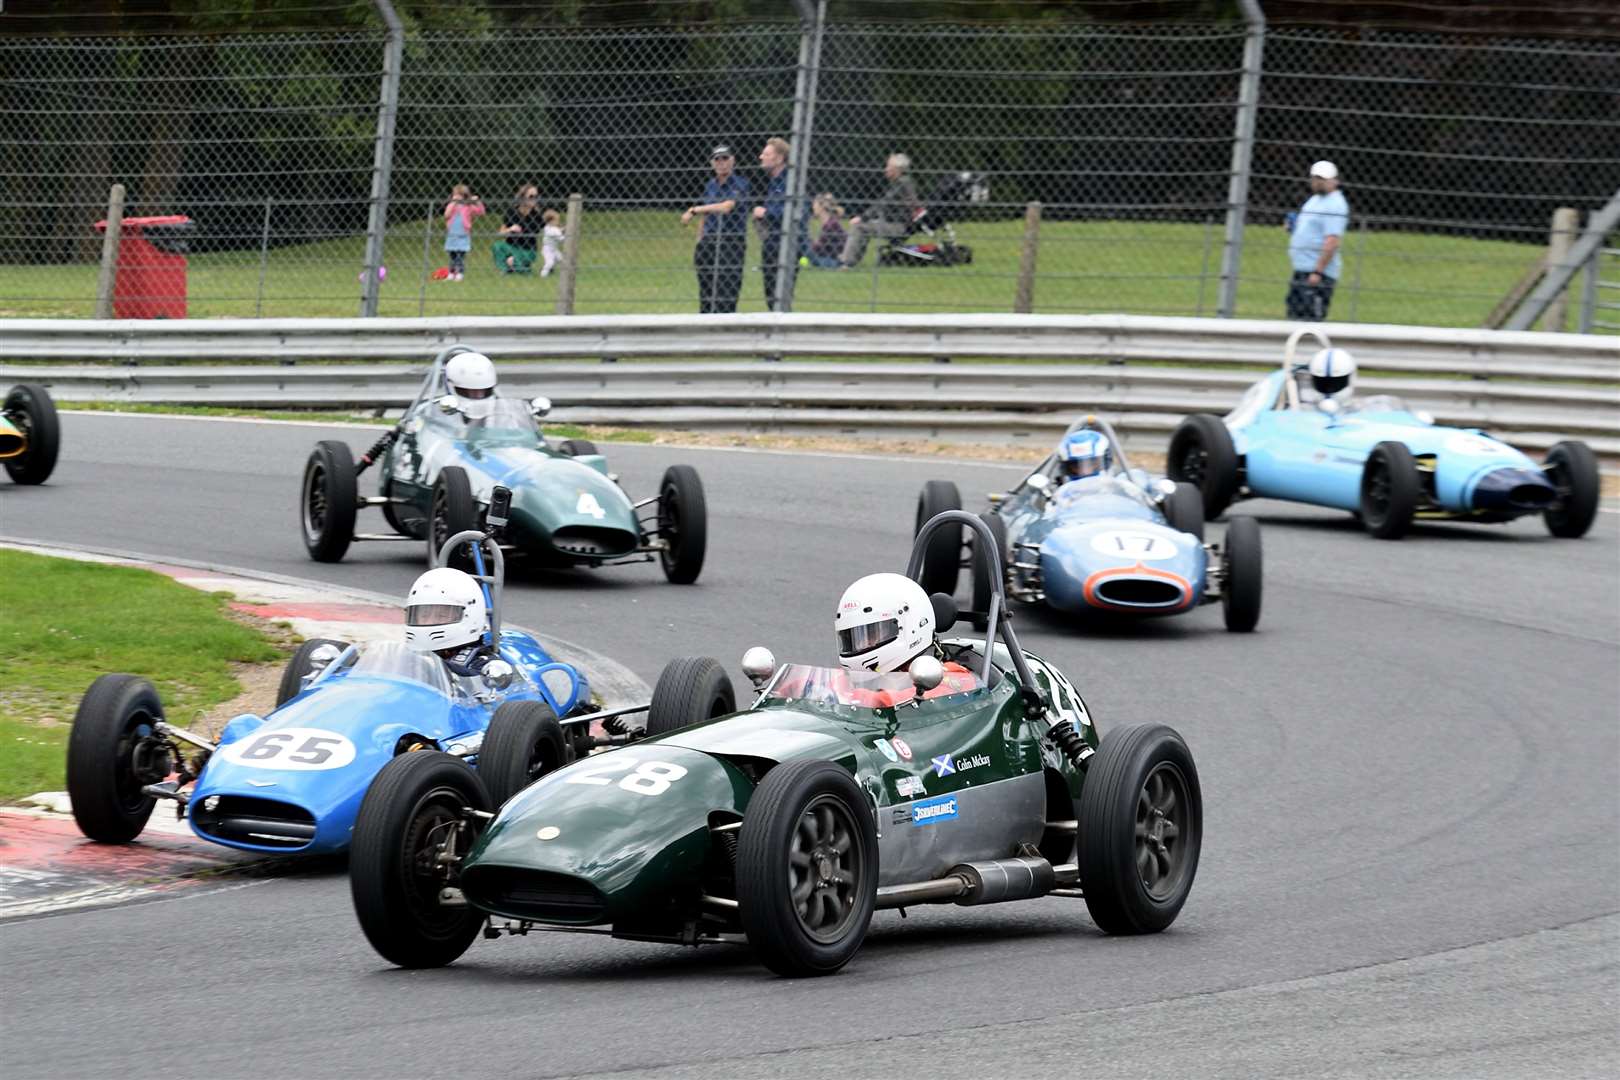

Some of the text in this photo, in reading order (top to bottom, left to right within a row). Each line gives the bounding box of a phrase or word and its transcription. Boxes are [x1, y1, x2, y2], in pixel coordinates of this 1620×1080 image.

[576, 493, 606, 519] 4
[1114, 536, 1155, 552] 17
[239, 733, 342, 765] 65
[565, 757, 689, 796] 28
[956, 757, 973, 772] Colin
